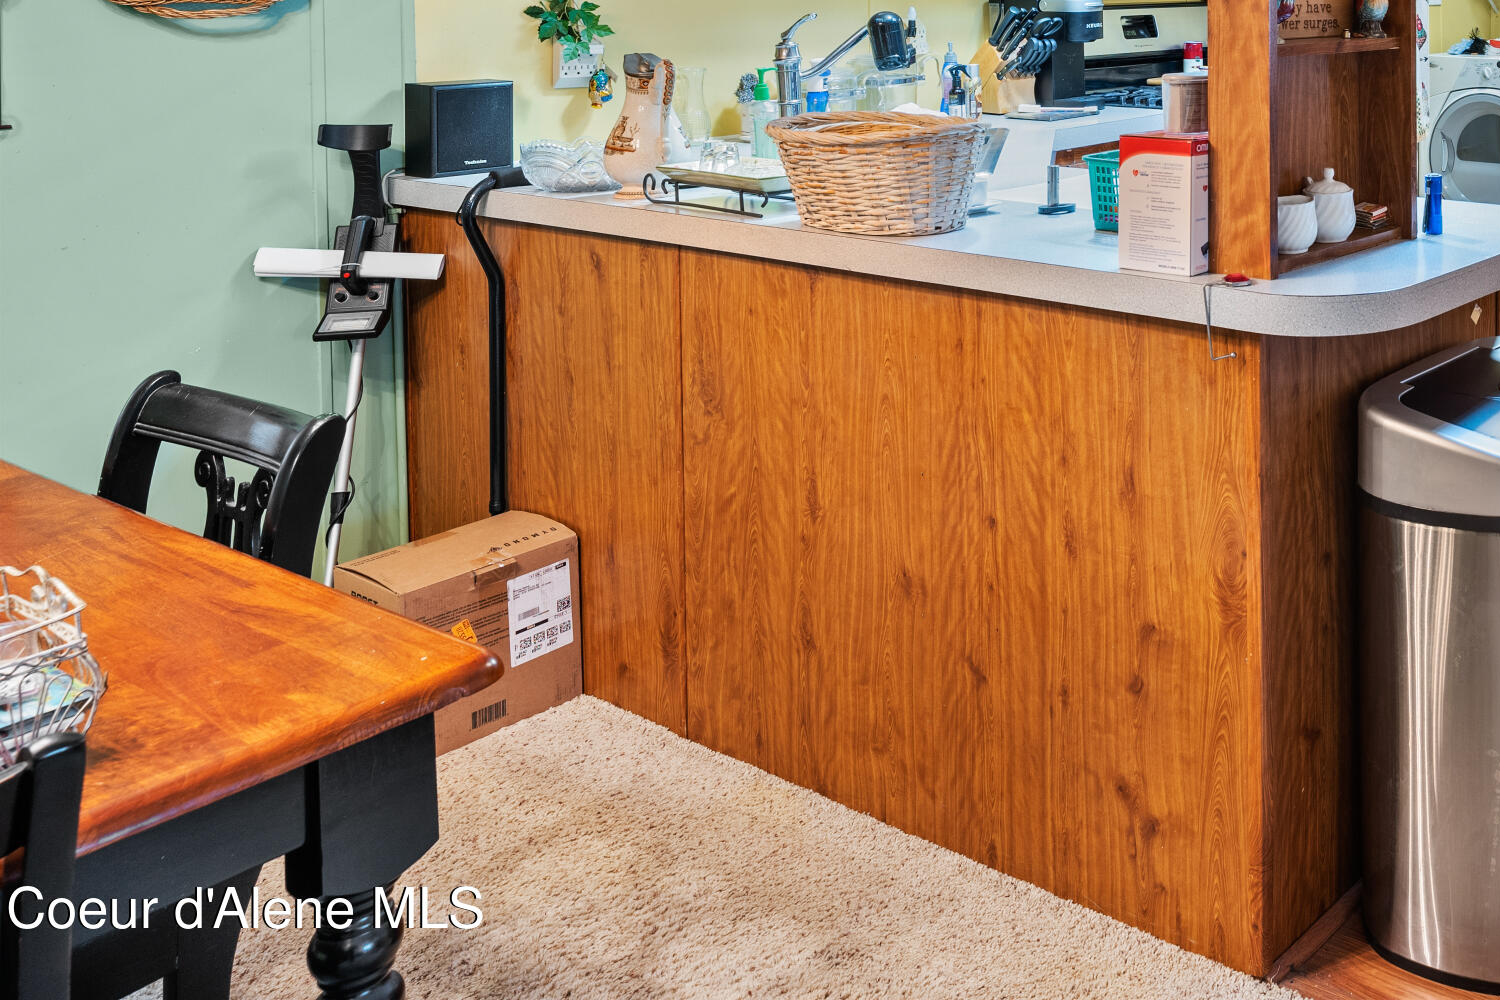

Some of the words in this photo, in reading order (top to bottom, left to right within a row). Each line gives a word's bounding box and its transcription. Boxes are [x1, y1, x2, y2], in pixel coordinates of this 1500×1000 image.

[1306, 1, 1332, 13] have
[1281, 20, 1301, 30] wer
[1303, 19, 1340, 32] surges.
